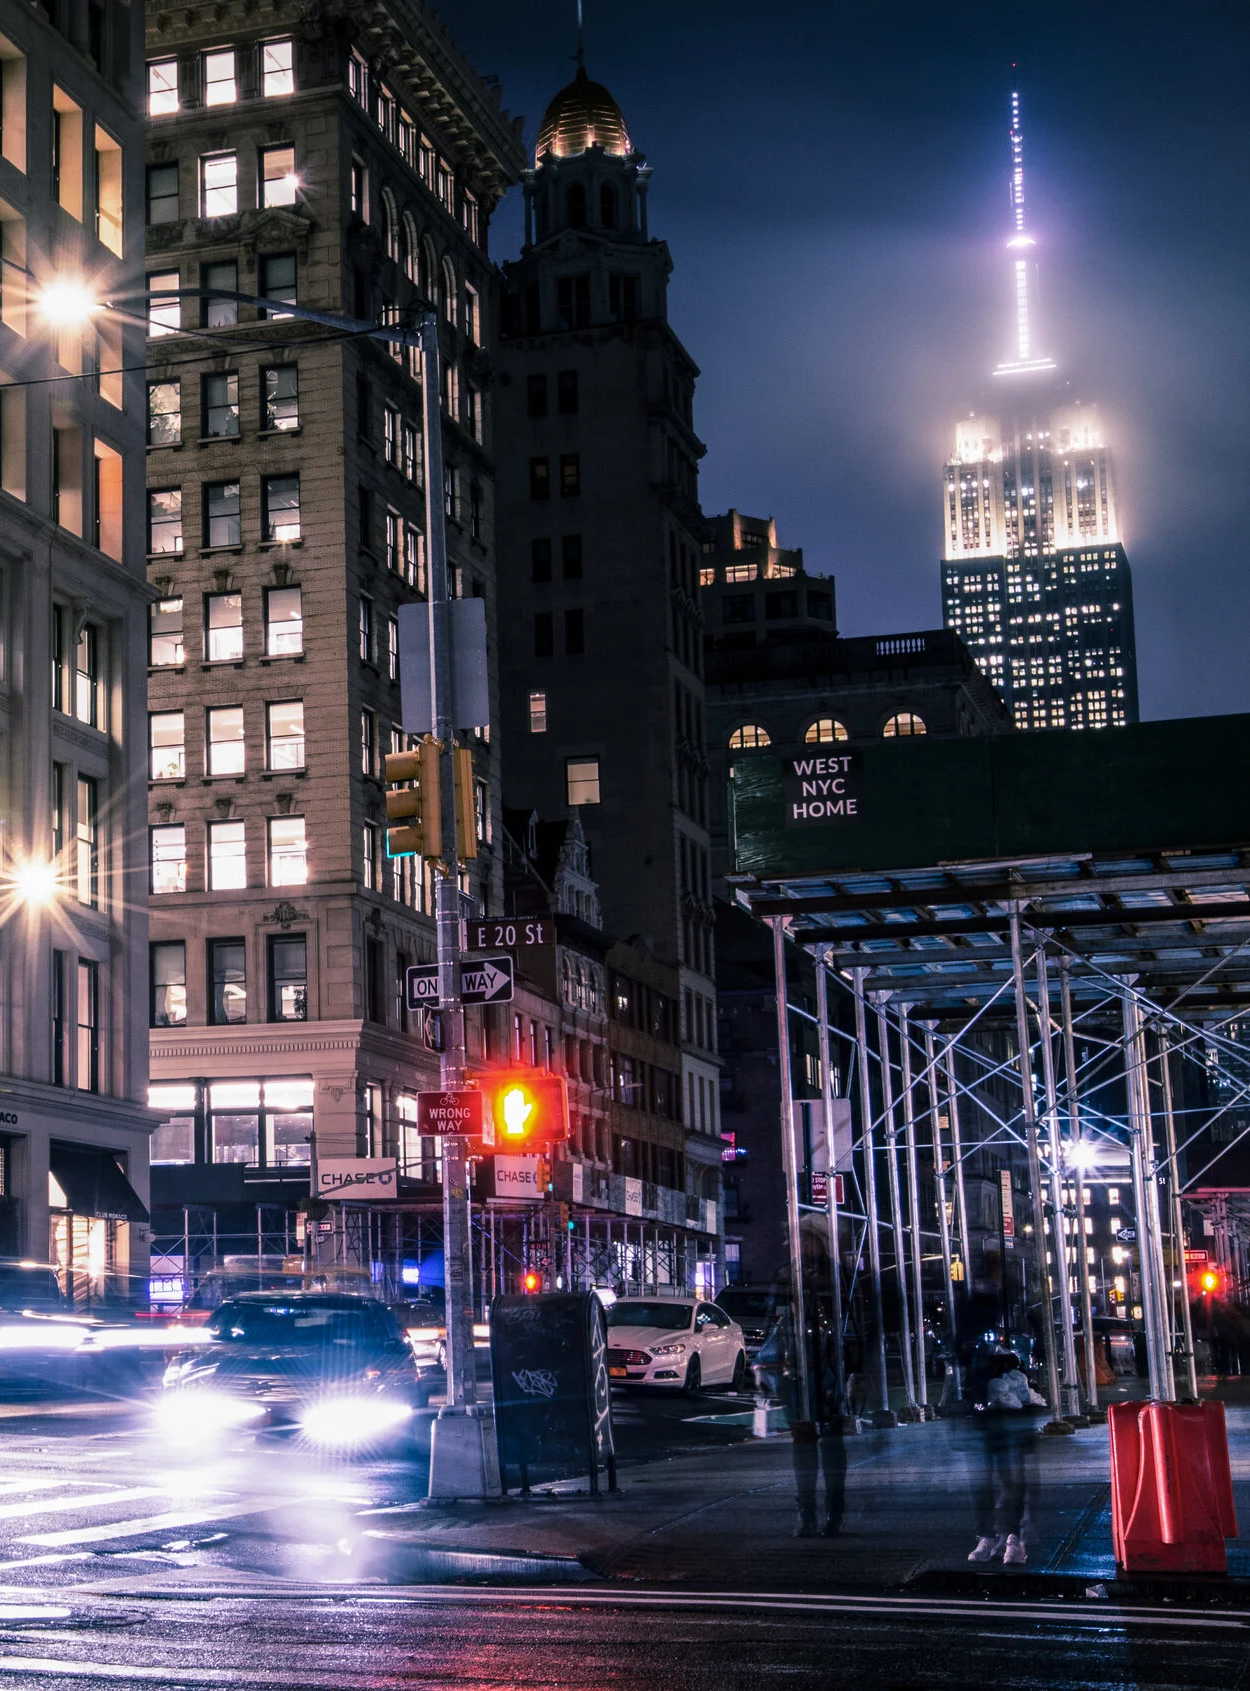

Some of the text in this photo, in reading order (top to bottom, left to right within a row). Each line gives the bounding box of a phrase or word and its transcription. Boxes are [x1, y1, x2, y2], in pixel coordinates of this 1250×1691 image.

[793, 756, 852, 776] WEST
[802, 778, 845, 797] NYC
[793, 799, 857, 819] HOME
[478, 923, 543, 947] E 20 St
[464, 972, 497, 991] WAY
[429, 1107, 471, 1119] WRONG
[437, 1120, 462, 1131] WAY
[321, 1173, 376, 1185] CHASE
[497, 1169, 531, 1183] CHASE
